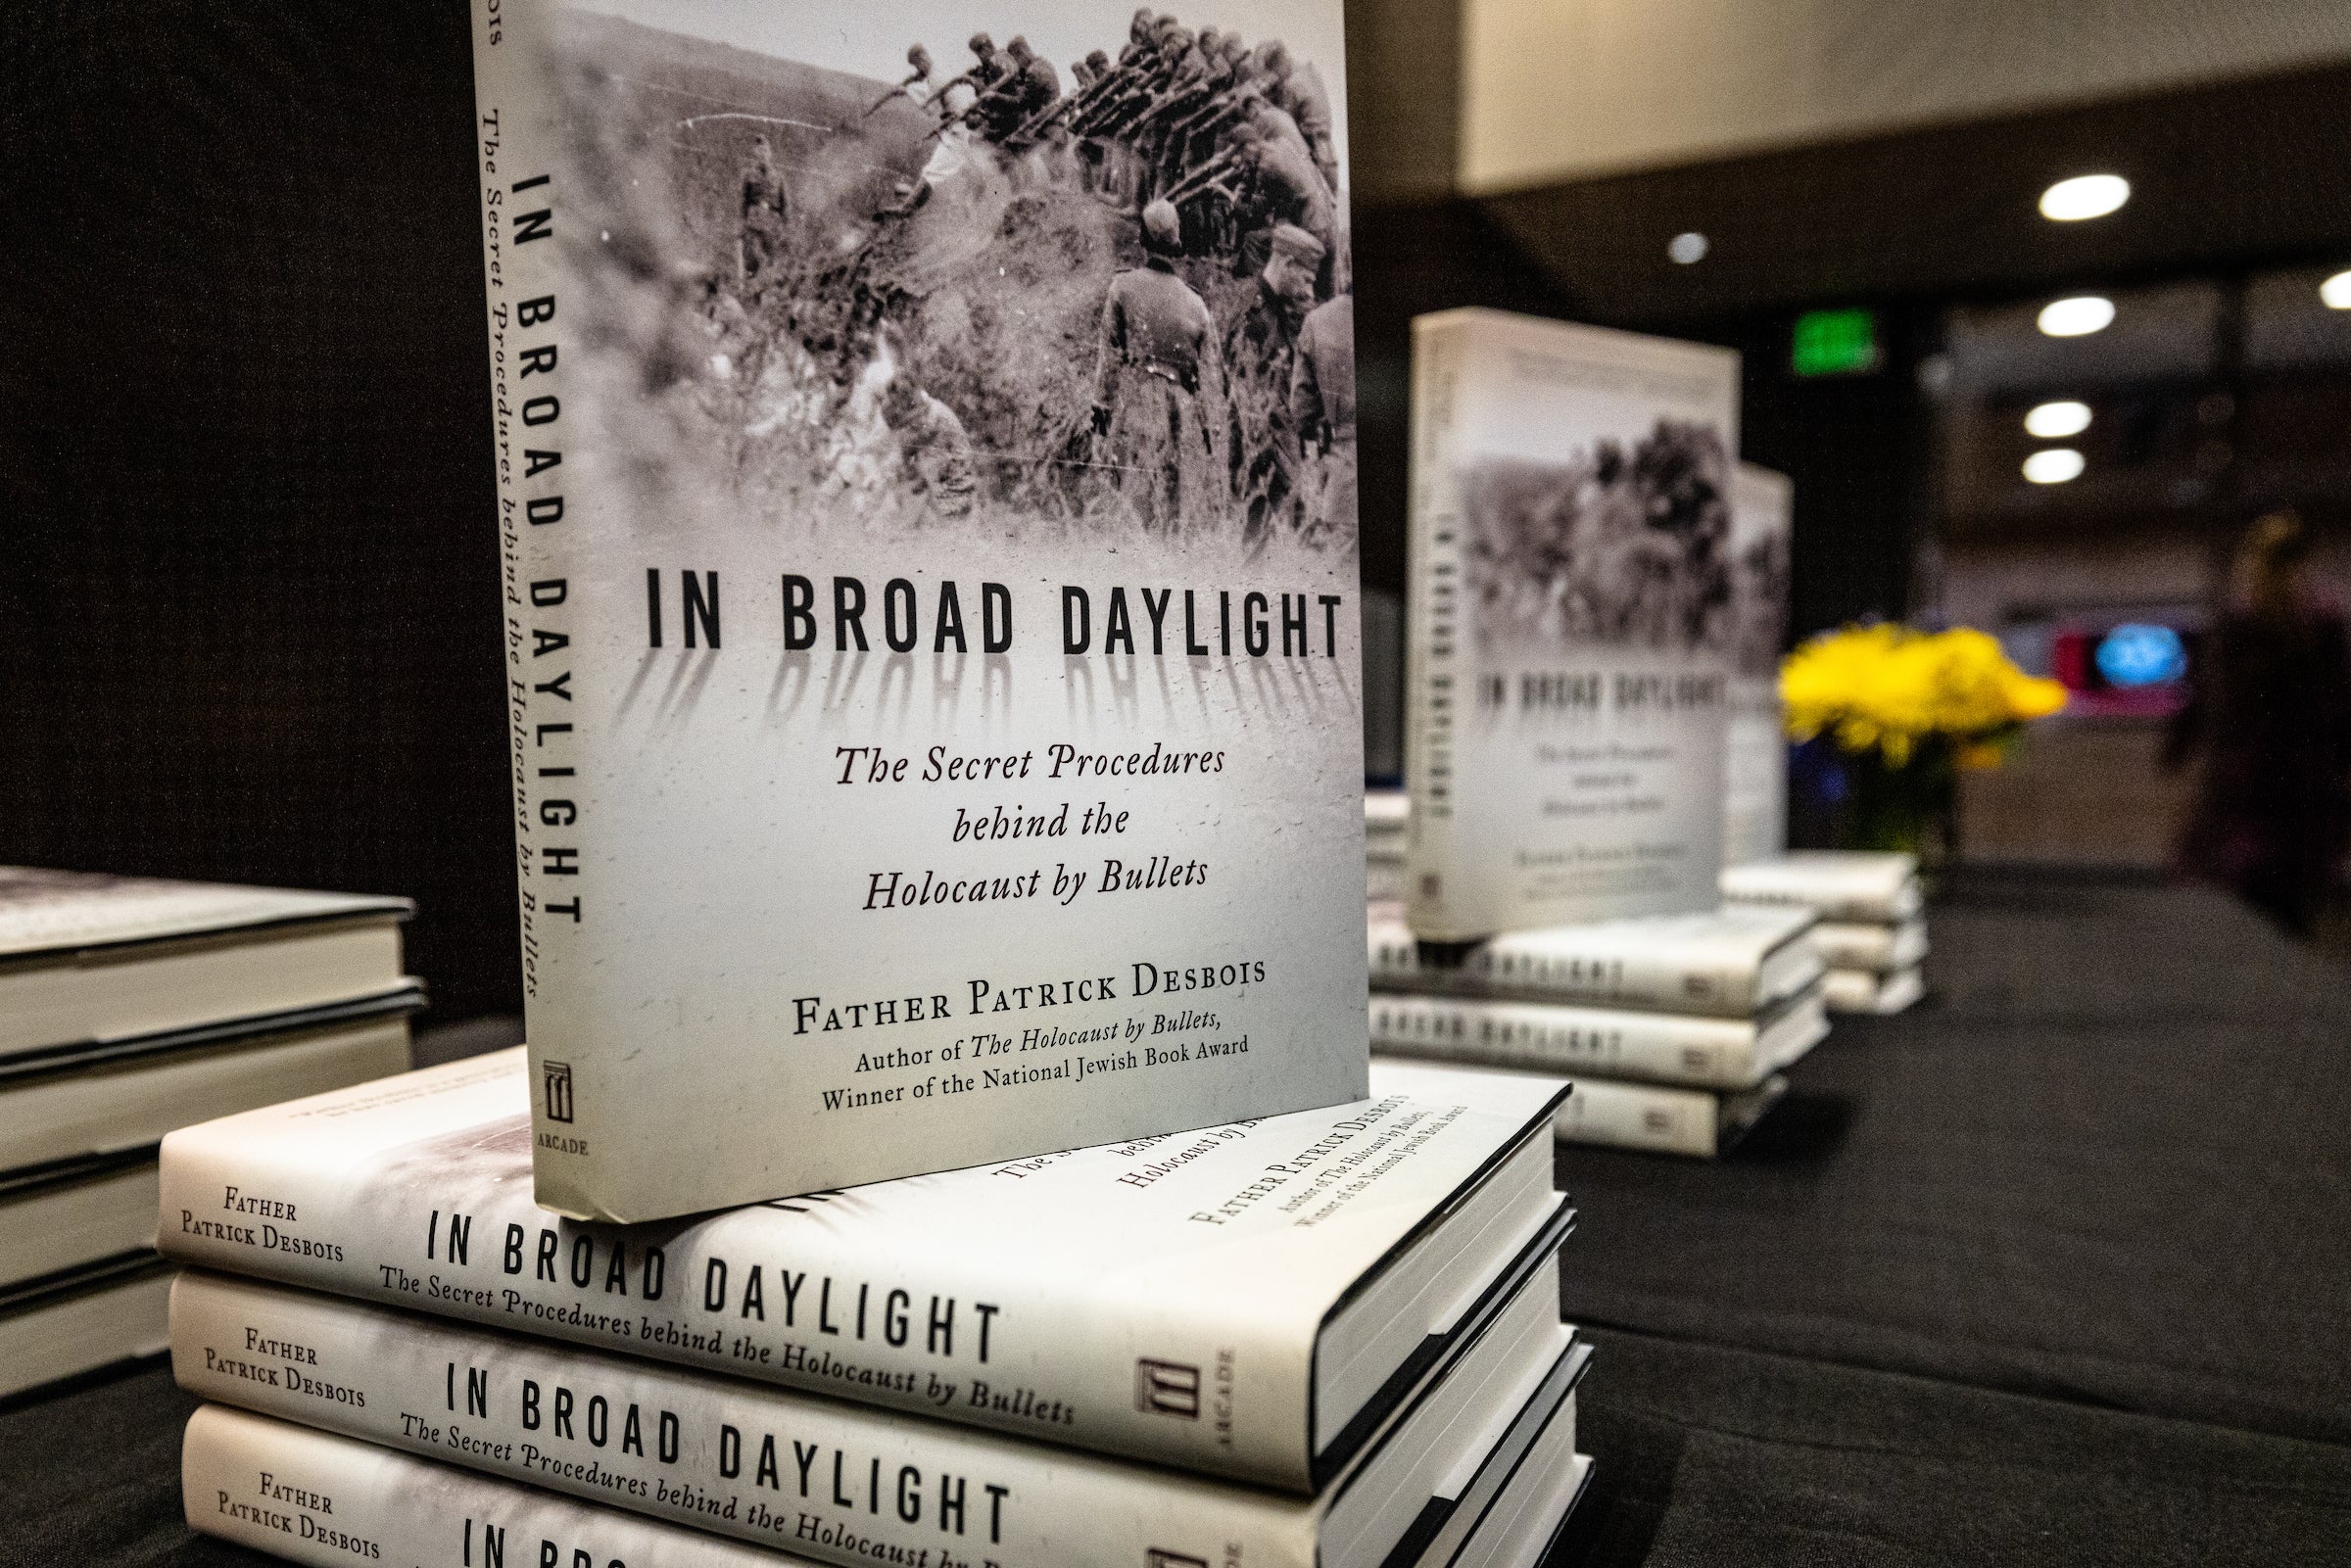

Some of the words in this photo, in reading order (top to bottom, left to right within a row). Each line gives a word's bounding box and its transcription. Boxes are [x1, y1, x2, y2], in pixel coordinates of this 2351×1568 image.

[483, 109, 500, 173] The
[511, 174, 552, 245] IN
[486, 186, 504, 289] Secret
[493, 302, 511, 486] Procedures
[517, 295, 563, 526] BROAD
[502, 498, 522, 605] behind
[647, 567, 722, 650] IN
[782, 573, 1013, 653] BROAD
[1062, 587, 1341, 658] DAYLIGHT
[507, 616, 523, 666] the
[511, 680, 530, 832] Holocaust
[529, 578, 581, 923] DAYLIGHT
[837, 745, 906, 784] The
[922, 745, 1032, 783] Secret
[1048, 743, 1225, 781] Procedures
[952, 803, 1068, 843] behind
[1081, 802, 1129, 834] the
[519, 843, 534, 878] by
[863, 868, 1038, 910] Holocaust
[1053, 864, 1086, 904] by
[1098, 859, 1208, 894] Bullets
[522, 889, 537, 998] Bullets
[792, 996, 951, 1036] FATHER
[967, 974, 1116, 1015] PATRICK
[1131, 960, 1267, 997] DESBOIS
[854, 1046, 934, 1074] Author
[940, 1040, 962, 1063] of
[972, 1033, 1013, 1058] The
[1021, 1022, 1120, 1052] Holocaust
[1125, 1020, 1146, 1040] by
[1152, 1008, 1222, 1036] Bullets,
[822, 1085, 905, 1112] Winner
[913, 1077, 935, 1097] of
[942, 1072, 975, 1094] the
[984, 1060, 1070, 1088] National
[1075, 1051, 1139, 1082] Jewish
[1145, 1043, 1191, 1066] Book
[1196, 1036, 1249, 1060] Award
[1386, 1129, 1406, 1143] by
[1420, 1117, 1449, 1136] Book
[1439, 1105, 1468, 1122] Award
[538, 1133, 589, 1156] ARCADE
[990, 1157, 1053, 1179] The
[1116, 1135, 1221, 1188] Holocaust
[1206, 1125, 1246, 1140] by
[1187, 1176, 1287, 1224] FATHER
[1266, 1132, 1354, 1173] PATRICK
[1332, 1095, 1410, 1130] DESBOIS
[1344, 1136, 1392, 1165] Holocaust
[1358, 1147, 1407, 1180] National
[1401, 1131, 1430, 1155] Jewish
[1316, 1174, 1333, 1188] of
[1320, 1159, 1352, 1179] The
[1346, 1176, 1370, 1191] the
[223, 1186, 297, 1221] FATHER
[1277, 1188, 1320, 1213] Author
[1337, 1190, 1356, 1201] of
[181, 1210, 256, 1245] PATRICK
[263, 1227, 344, 1262] DESBOIS
[427, 1210, 471, 1265] IN
[504, 1223, 666, 1301] BROAD
[704, 1257, 1001, 1364] DAYLIGHT
[244, 1328, 317, 1366] FATHER
[379, 1263, 420, 1295] The
[428, 1275, 494, 1307] Secret
[502, 1289, 632, 1337] Procedures
[641, 1316, 723, 1355] behind
[733, 1335, 771, 1364] the
[783, 1343, 917, 1393] Holocaust
[926, 1376, 957, 1406] by
[969, 1381, 1076, 1427] Bullets
[204, 1348, 278, 1387] PATRICK
[285, 1368, 365, 1407] DESBOIS
[446, 1362, 489, 1418] IN
[522, 1380, 680, 1463] BROAD
[719, 1425, 1010, 1544] DAYLIGHT
[260, 1472, 333, 1515] FATHER
[401, 1412, 441, 1443] The
[447, 1426, 512, 1461] Secret
[521, 1443, 648, 1497] Procedures
[656, 1477, 737, 1519] behind
[746, 1495, 785, 1532] the
[795, 1512, 930, 1567] Holocaust
[217, 1491, 292, 1534] PATRICK
[300, 1516, 380, 1560] DESBOIS
[463, 1518, 504, 1568] IN
